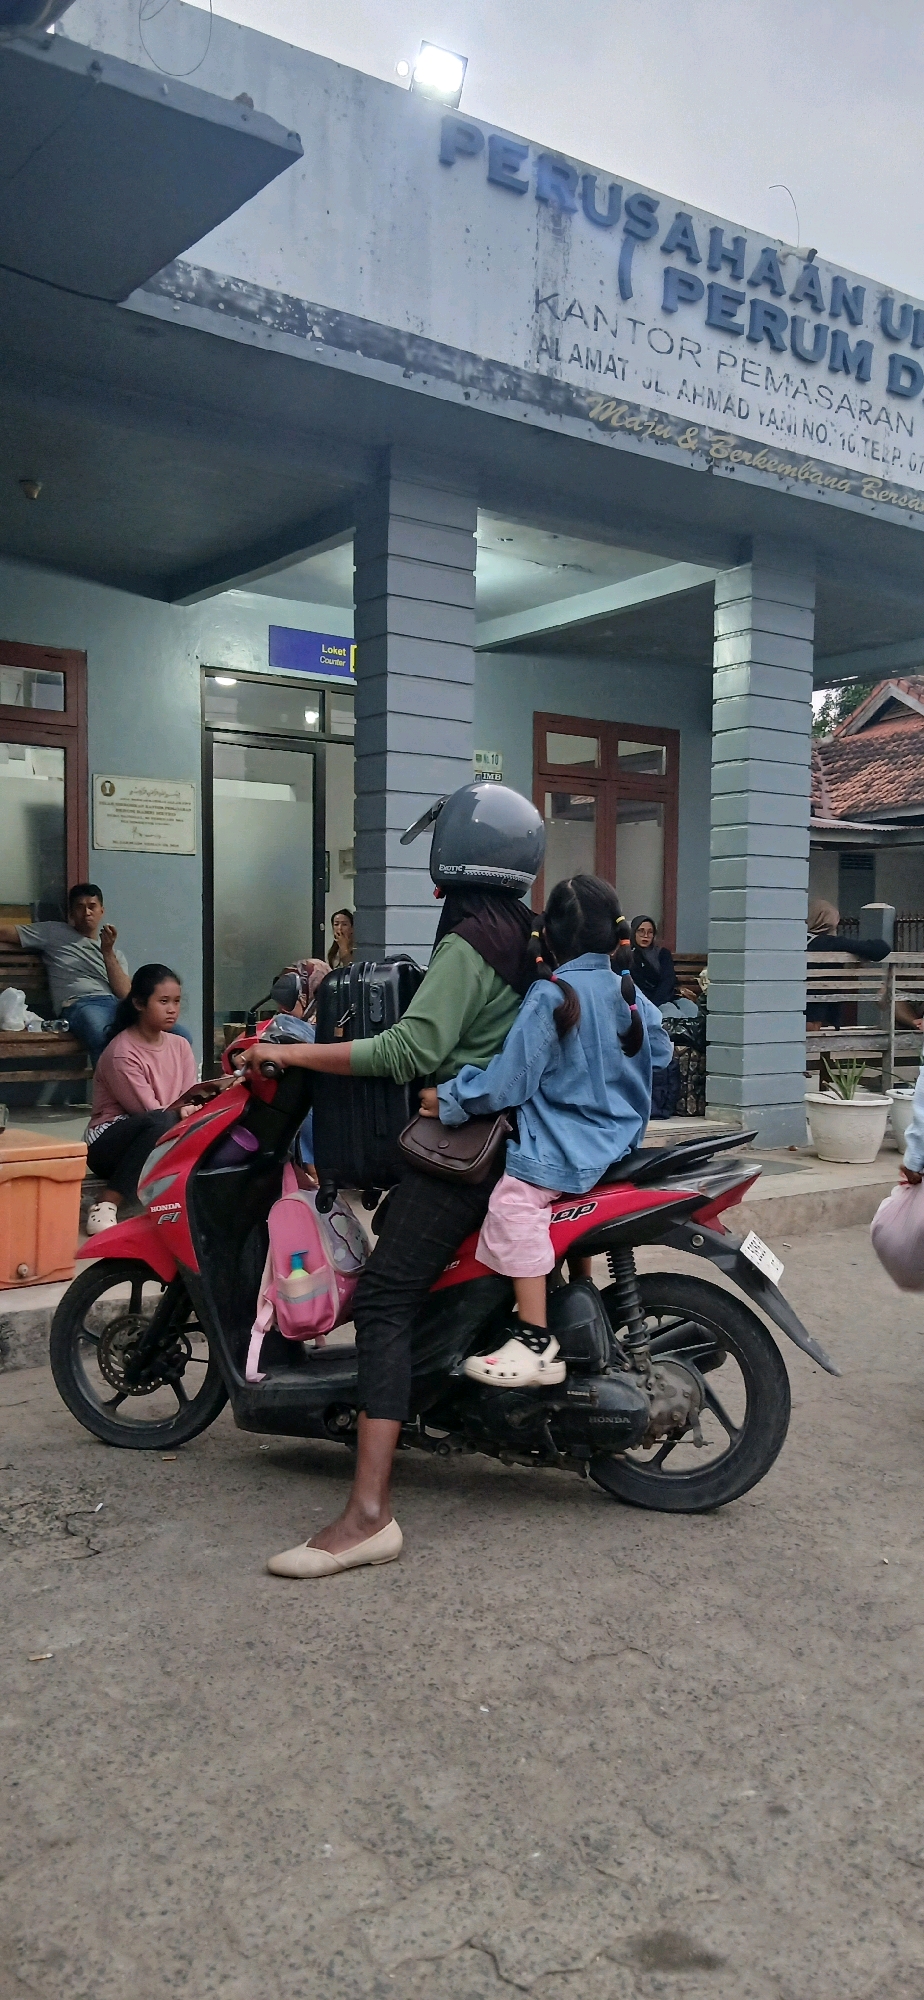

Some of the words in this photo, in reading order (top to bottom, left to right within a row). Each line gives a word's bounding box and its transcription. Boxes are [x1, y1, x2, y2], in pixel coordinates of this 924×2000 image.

[438, 114, 866, 325] PERUSAHAAN
[534, 288, 702, 368] KANTOR
[716, 350, 914, 438] PEMASARAN
[885, 352, 924, 406] D
[676, 379, 749, 420] AHMAD
[586, 396, 673, 438] Maju
[677, 427, 700, 450] &
[709, 435, 852, 494] Berkembang
[319, 656, 346, 667] Counter
[321, 644, 347, 656] Loket
[150, 1202, 181, 1213] HONDA
[549, 1202, 598, 1223] op
[589, 1415, 631, 1424] HONDA
